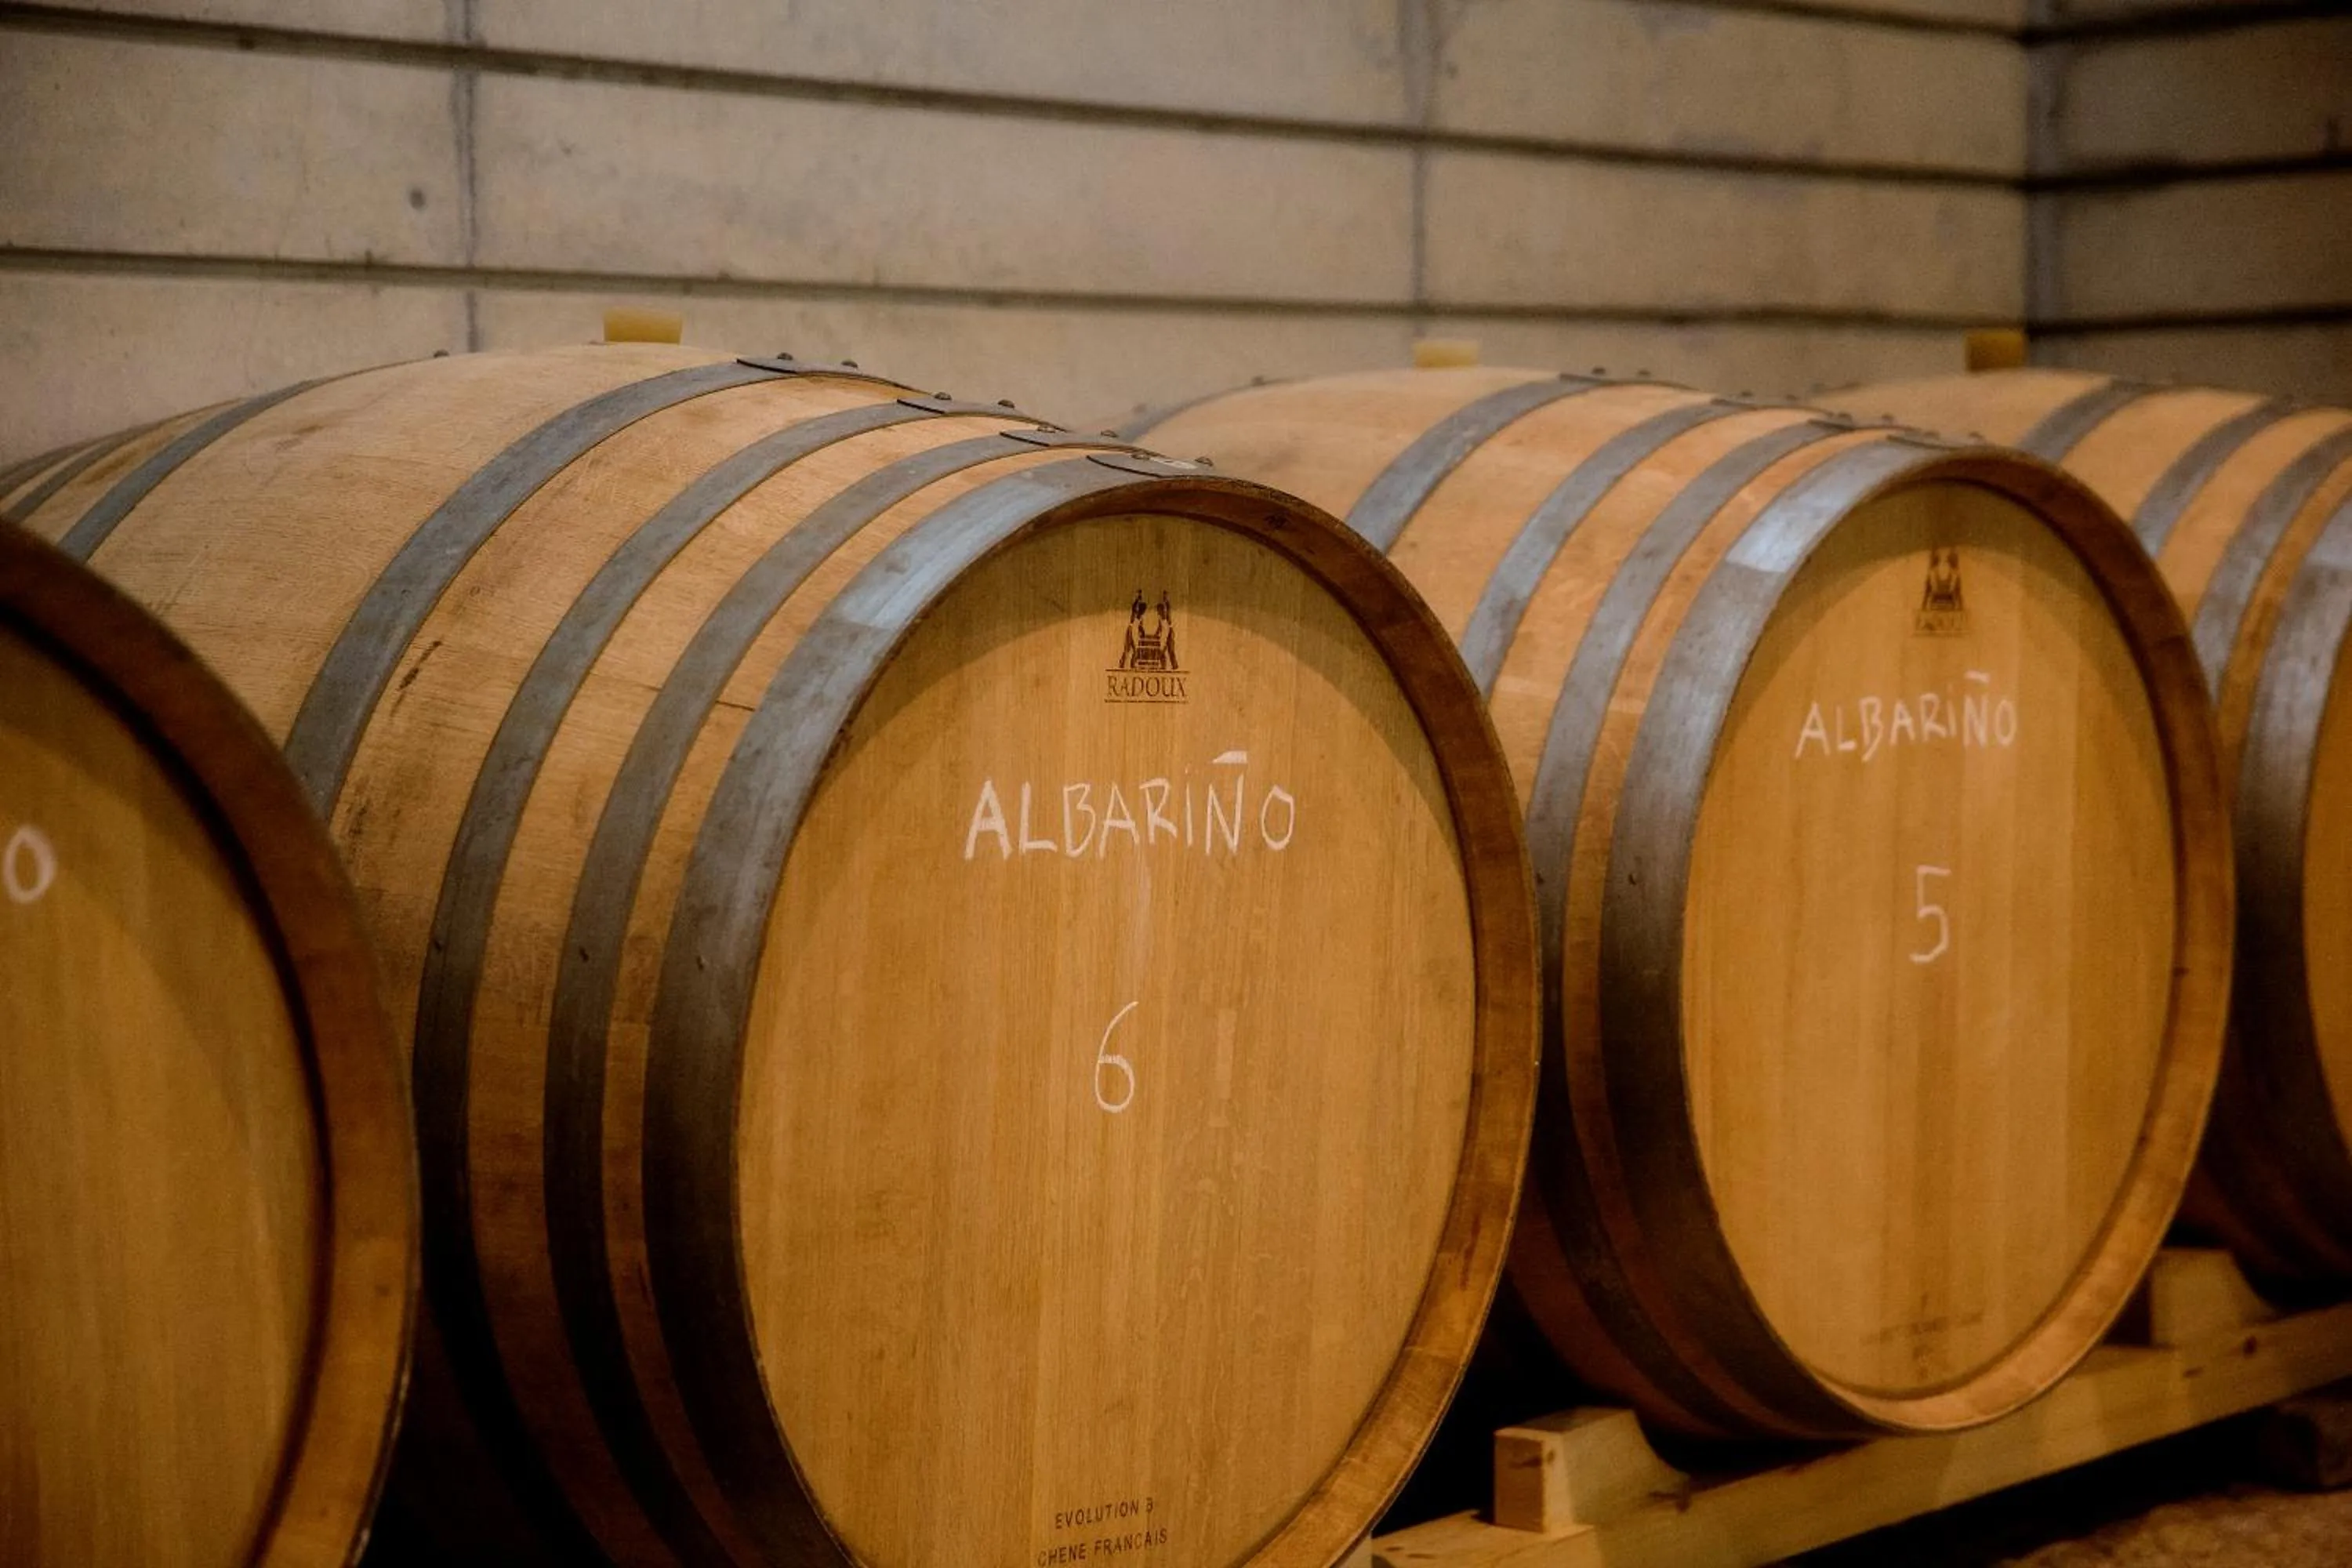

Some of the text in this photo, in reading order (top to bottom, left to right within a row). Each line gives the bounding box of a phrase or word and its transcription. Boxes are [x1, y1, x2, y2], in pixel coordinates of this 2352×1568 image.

[1106, 675, 1188, 697] RADOUX
[1909, 865, 1952, 964] 5
[1095, 1001, 1139, 1113] 6
[1055, 1499, 1139, 1530] EVOLUTION
[1037, 1542, 1087, 1567] CHENE
